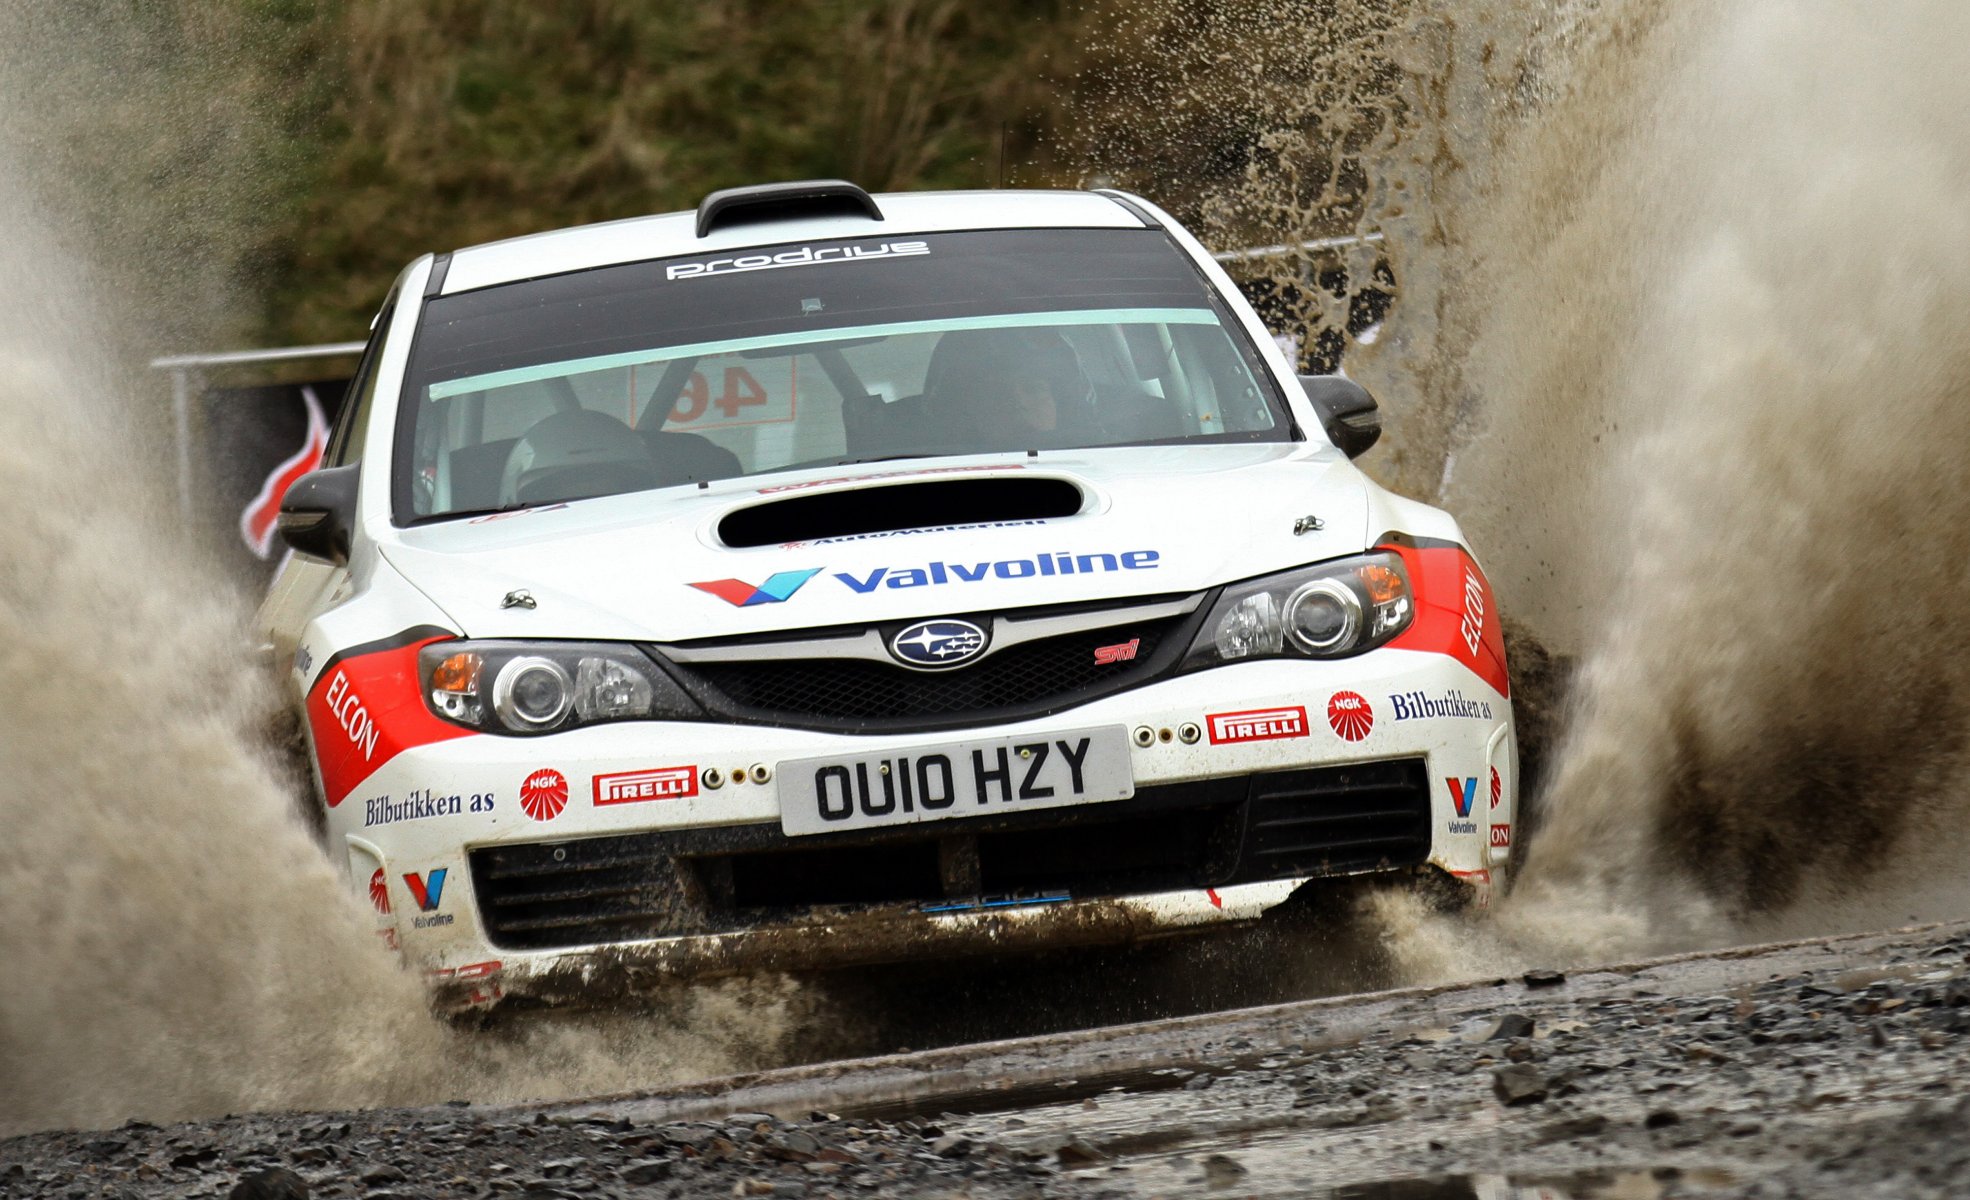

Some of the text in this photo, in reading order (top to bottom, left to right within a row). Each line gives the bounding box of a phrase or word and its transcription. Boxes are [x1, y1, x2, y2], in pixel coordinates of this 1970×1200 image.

[833, 550, 1160, 593] Valvoline
[1461, 565, 1484, 657] ELCON
[325, 669, 380, 762] ELCON
[1335, 697, 1362, 711] NGK
[1389, 690, 1493, 721] Bilbutikken as
[1213, 709, 1301, 740] PIRELLI
[529, 775, 558, 790] NGK
[599, 769, 691, 801] PIRELLI
[815, 738, 1092, 822] OU10 HZY
[365, 788, 495, 828] Bilbutikken as
[1448, 821, 1477, 834] Valvoline
[411, 913, 454, 929] Valvoline
